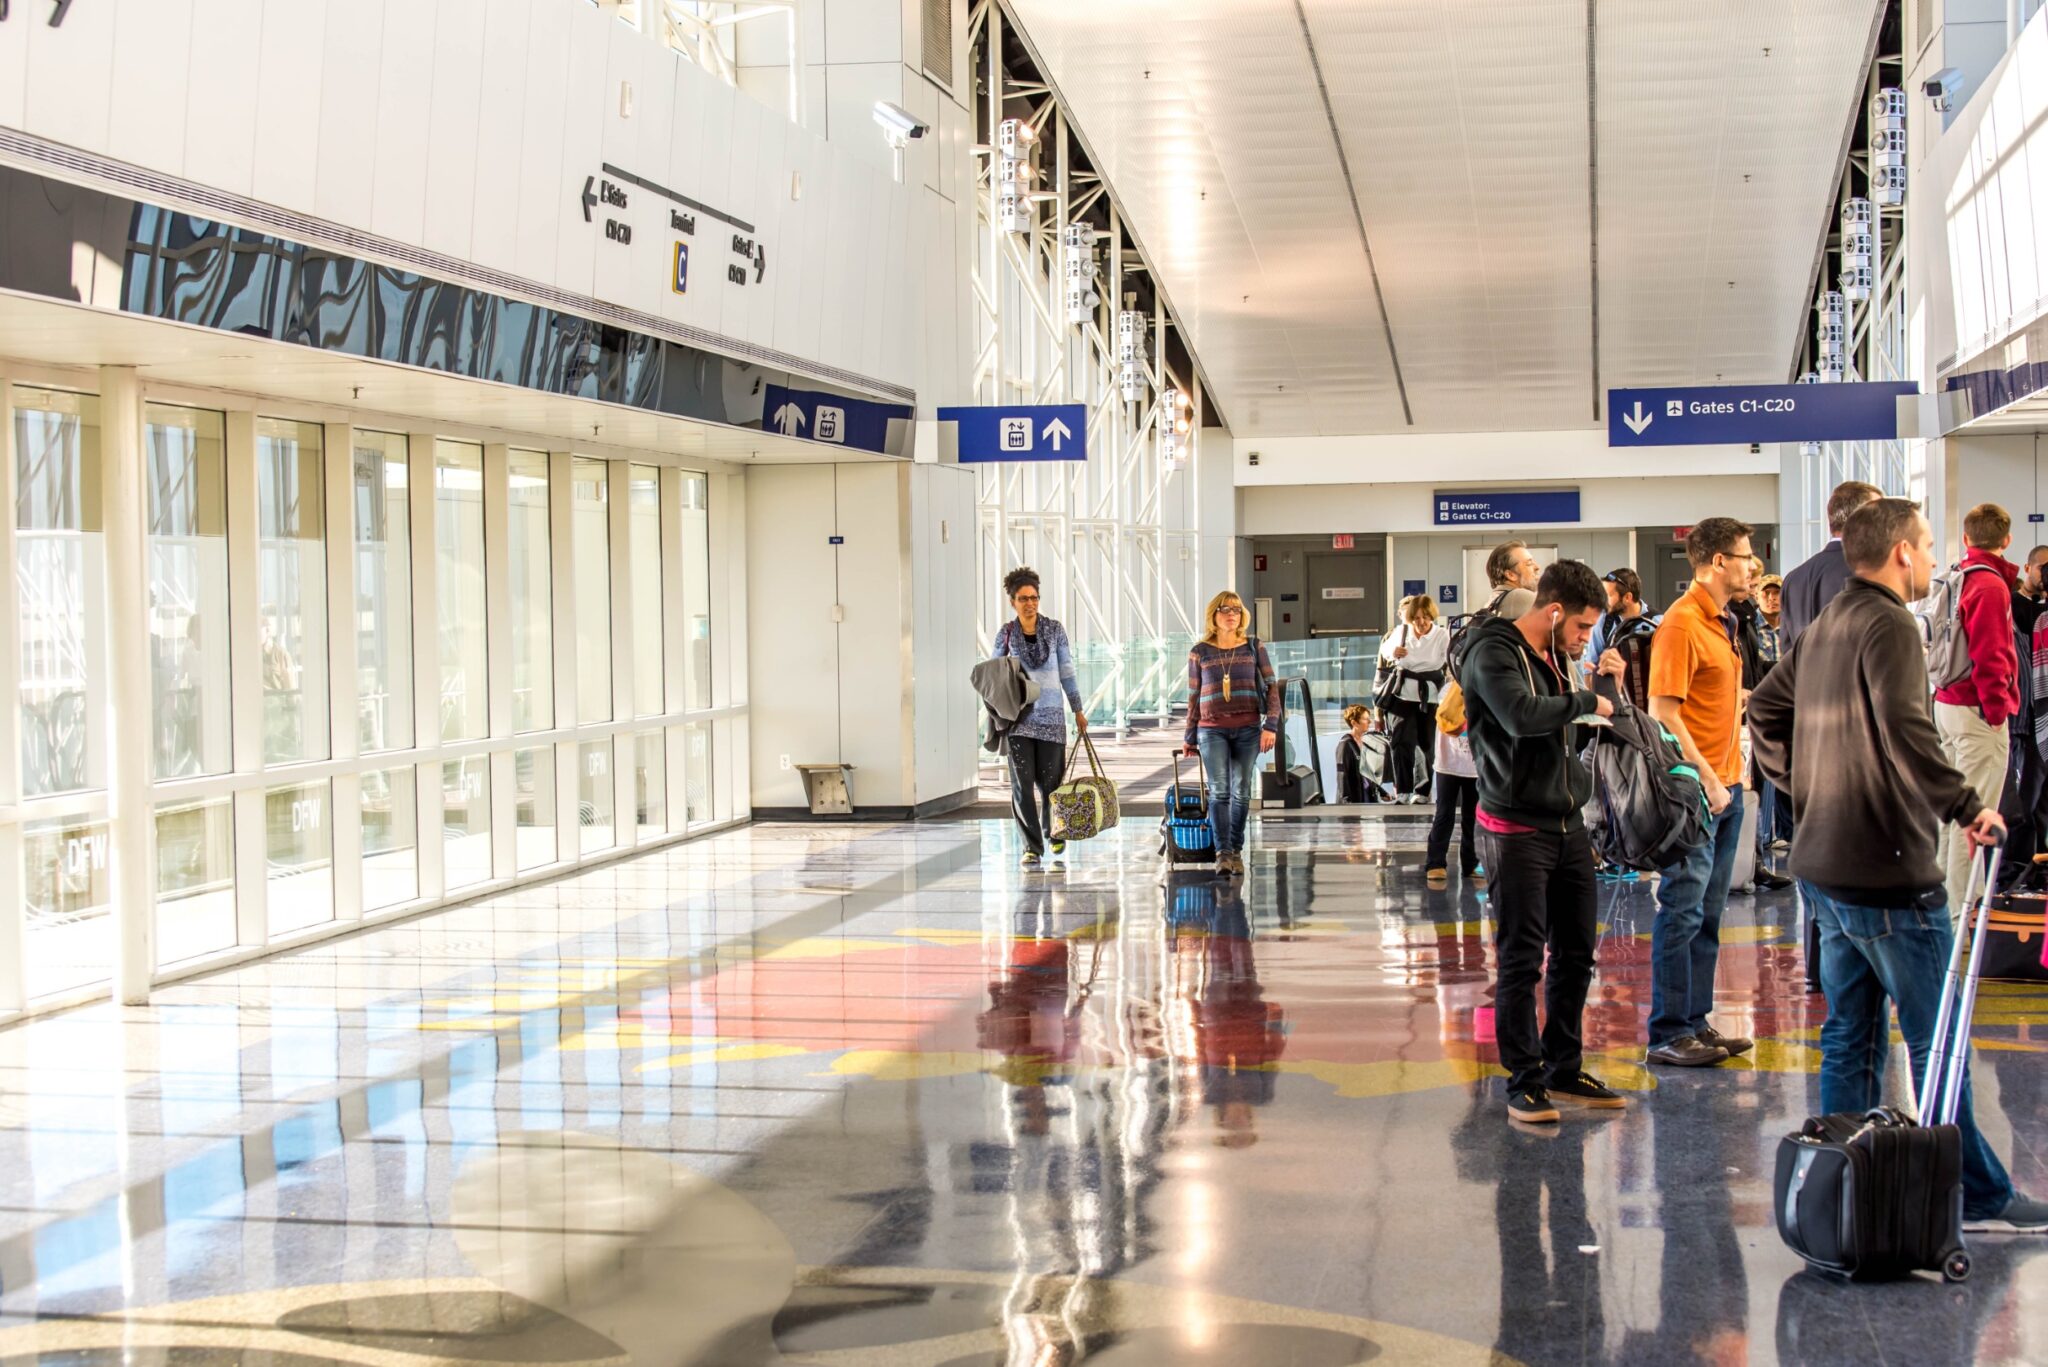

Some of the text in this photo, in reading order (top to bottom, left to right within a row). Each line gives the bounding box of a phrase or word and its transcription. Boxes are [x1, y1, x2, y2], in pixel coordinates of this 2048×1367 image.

[679, 251, 686, 285] C
[1690, 398, 1795, 415] Gates C1-C20
[1452, 502, 1490, 510] Elevator:
[1480, 512, 1511, 520] C1-C20
[588, 751, 607, 777] DFW
[460, 771, 482, 800] DFW
[292, 798, 321, 832] DFW
[68, 833, 107, 874] DFW
